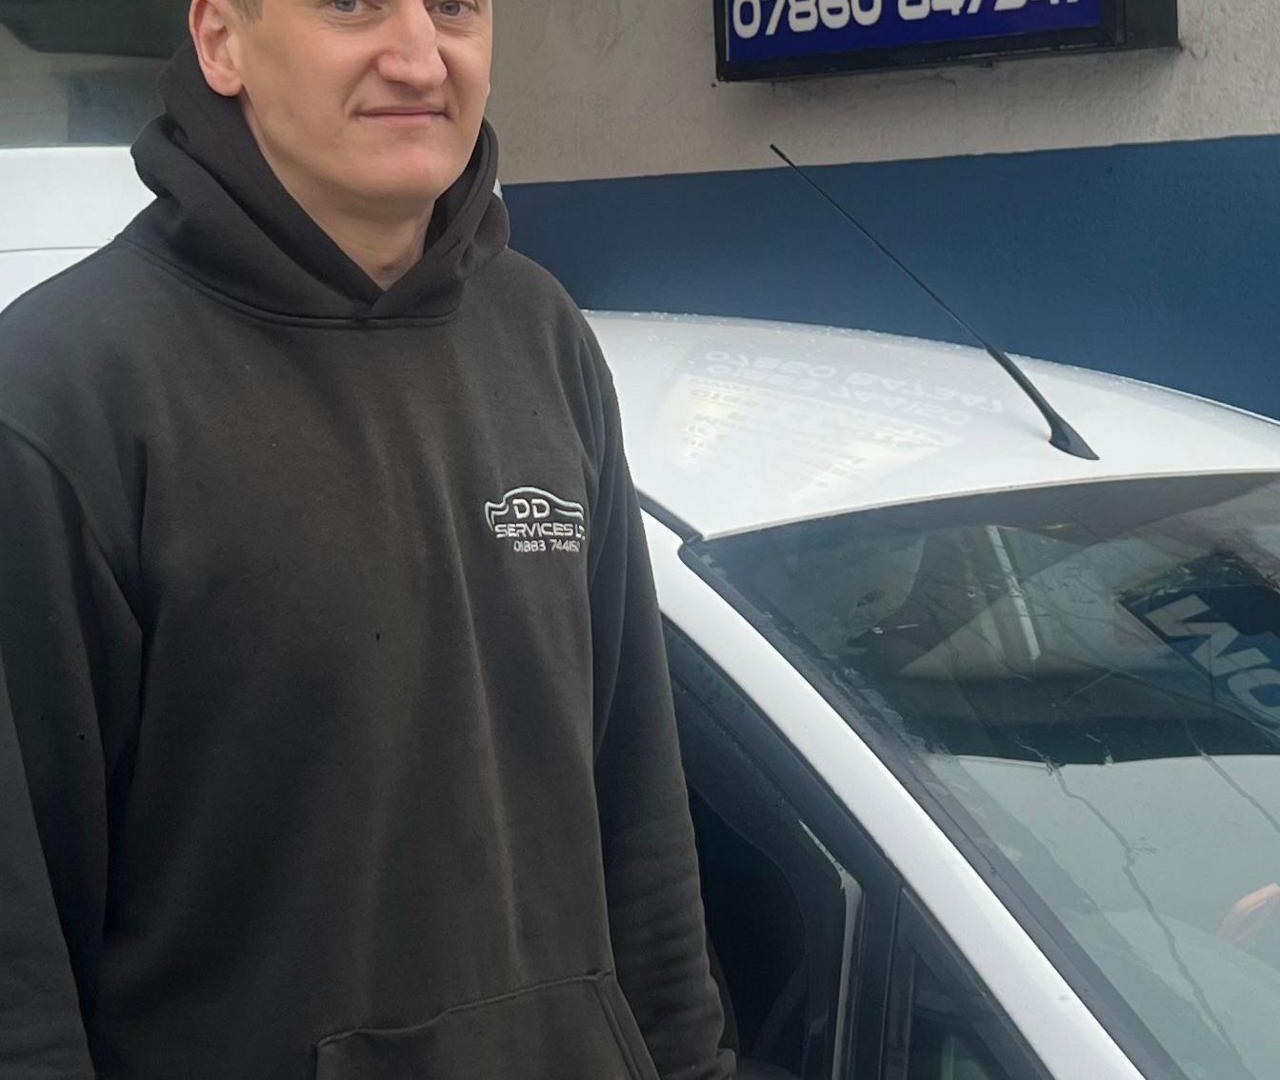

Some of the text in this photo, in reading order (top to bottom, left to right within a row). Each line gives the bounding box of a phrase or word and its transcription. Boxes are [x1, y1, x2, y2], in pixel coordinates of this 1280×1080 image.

[512, 498, 551, 519] DD
[494, 522, 574, 539] SERVICES
[513, 540, 547, 553] 01883
